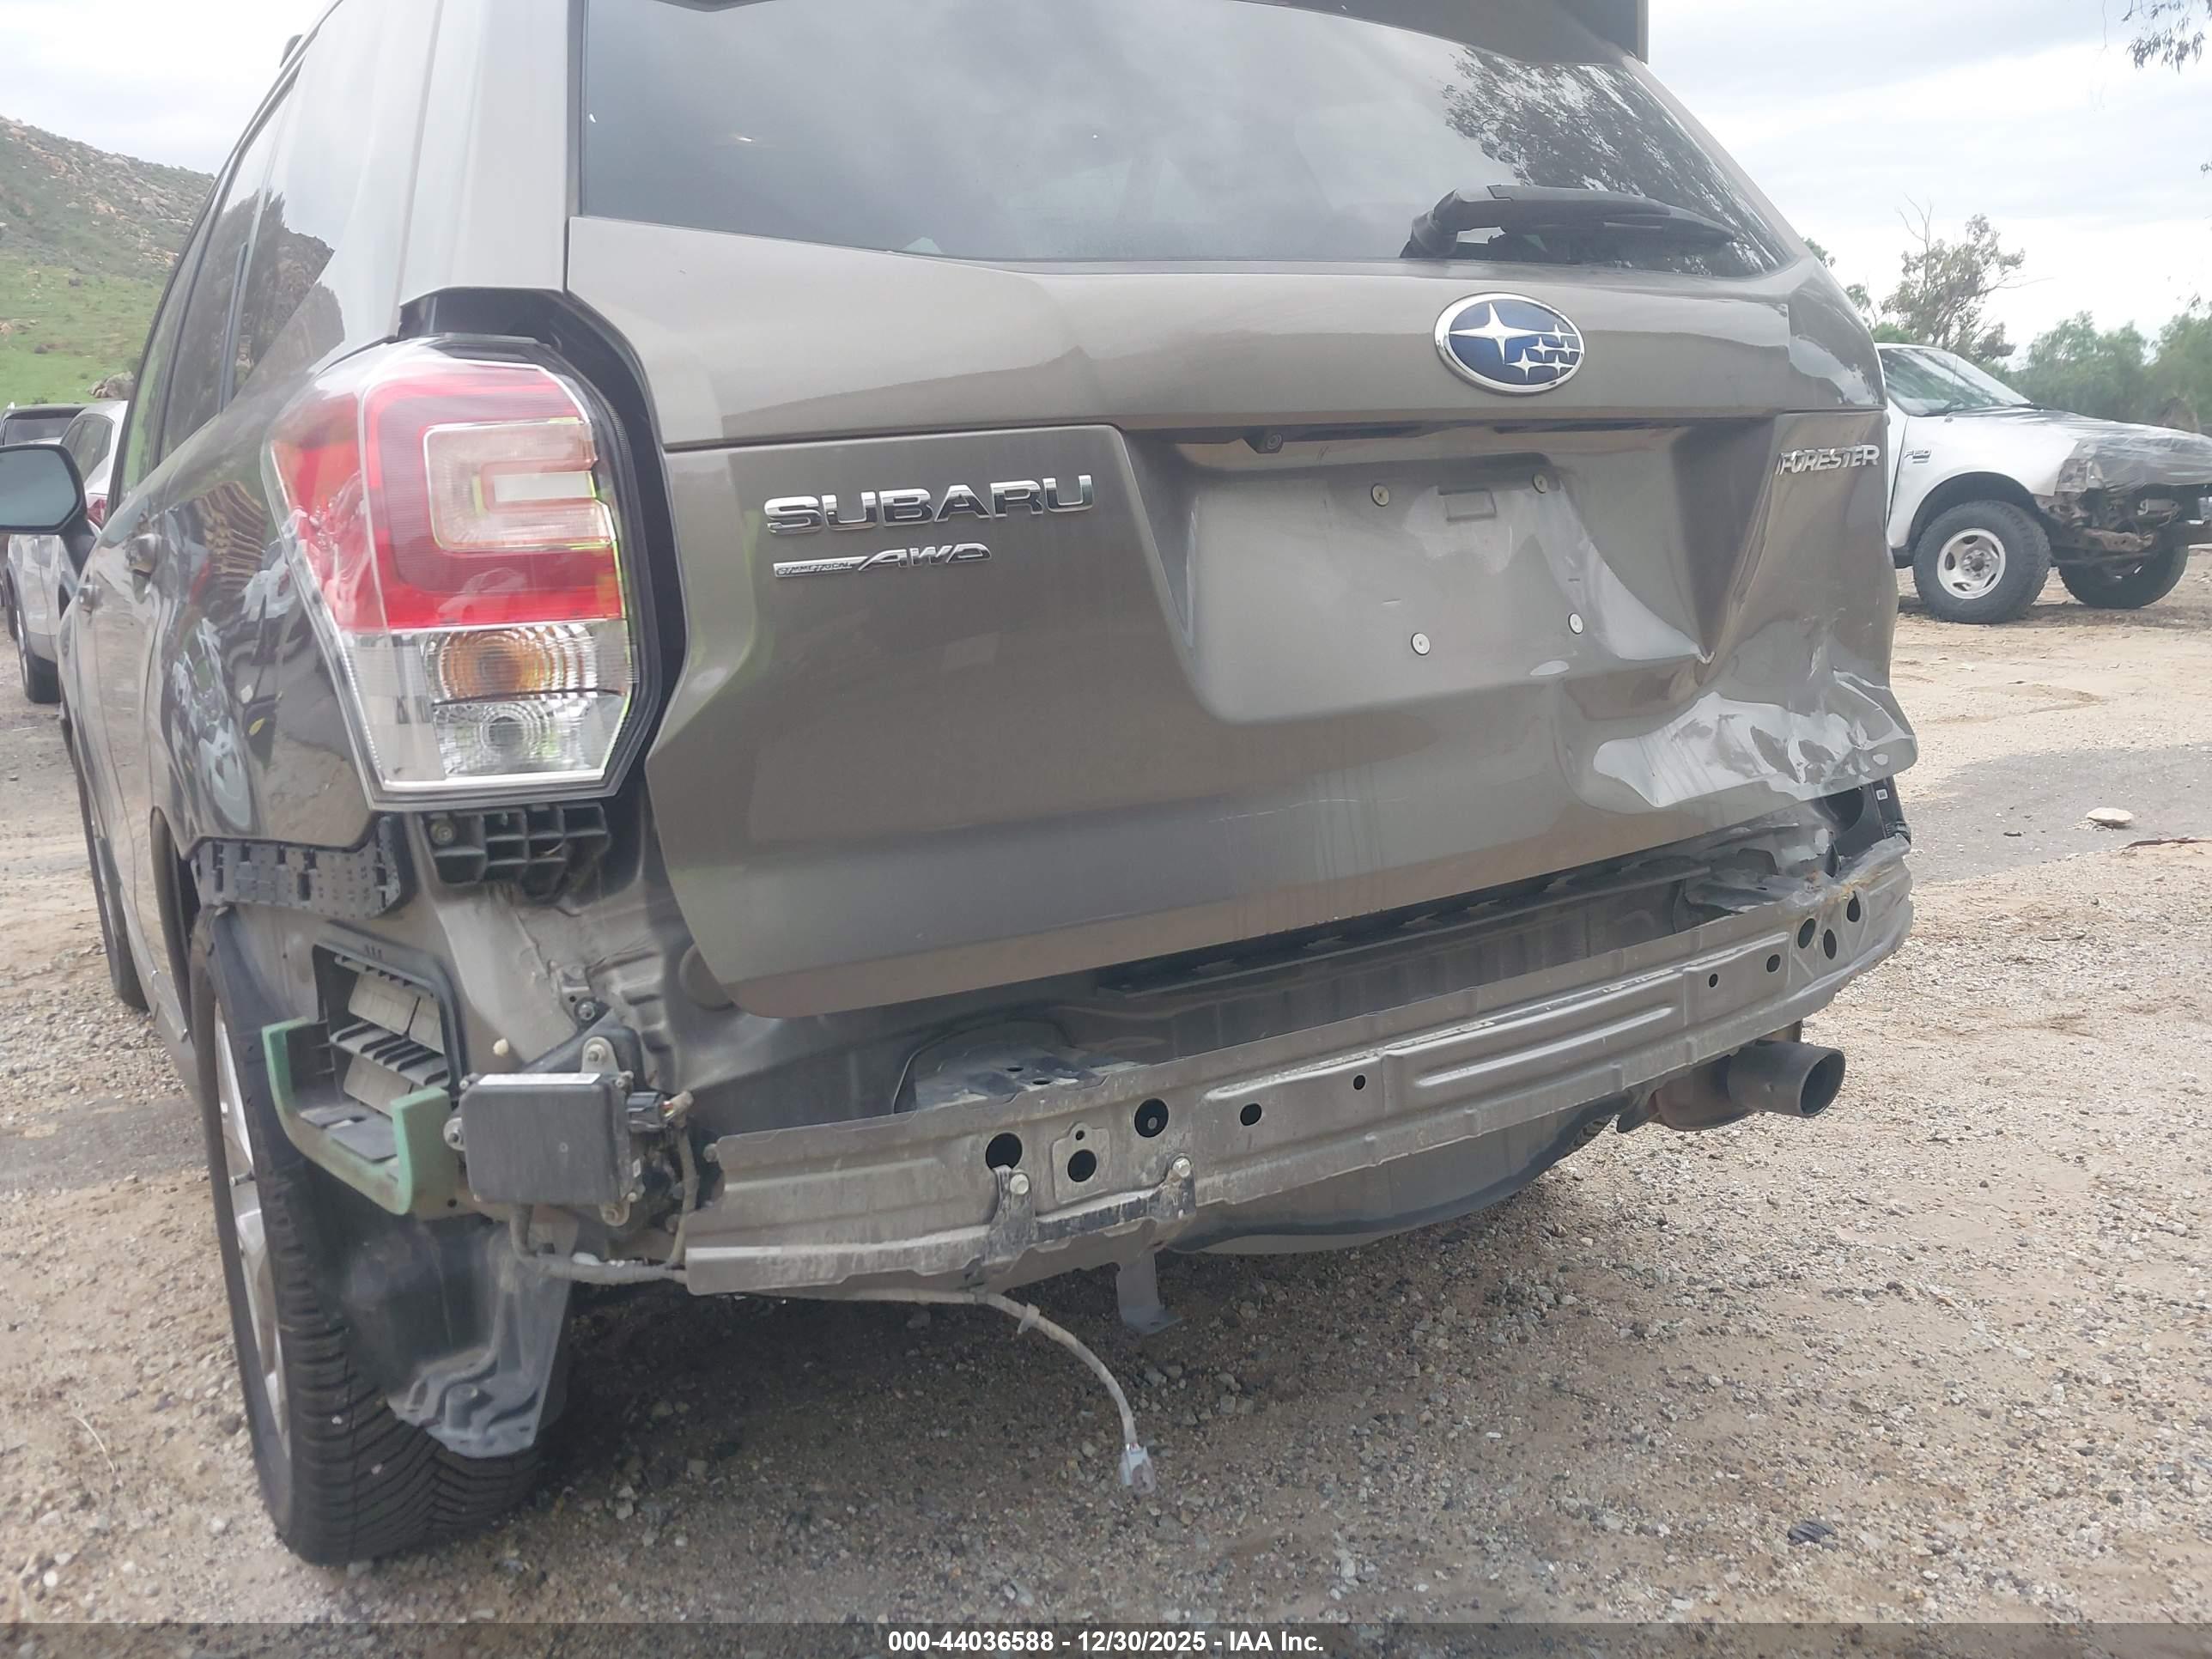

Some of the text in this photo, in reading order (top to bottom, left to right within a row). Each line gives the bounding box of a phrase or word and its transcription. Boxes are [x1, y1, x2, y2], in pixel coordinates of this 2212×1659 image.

[1775, 444, 1881, 476] FORESTER
[764, 474, 1096, 534] SUBARU
[775, 543, 993, 576] SYMMETRICAL AWD
